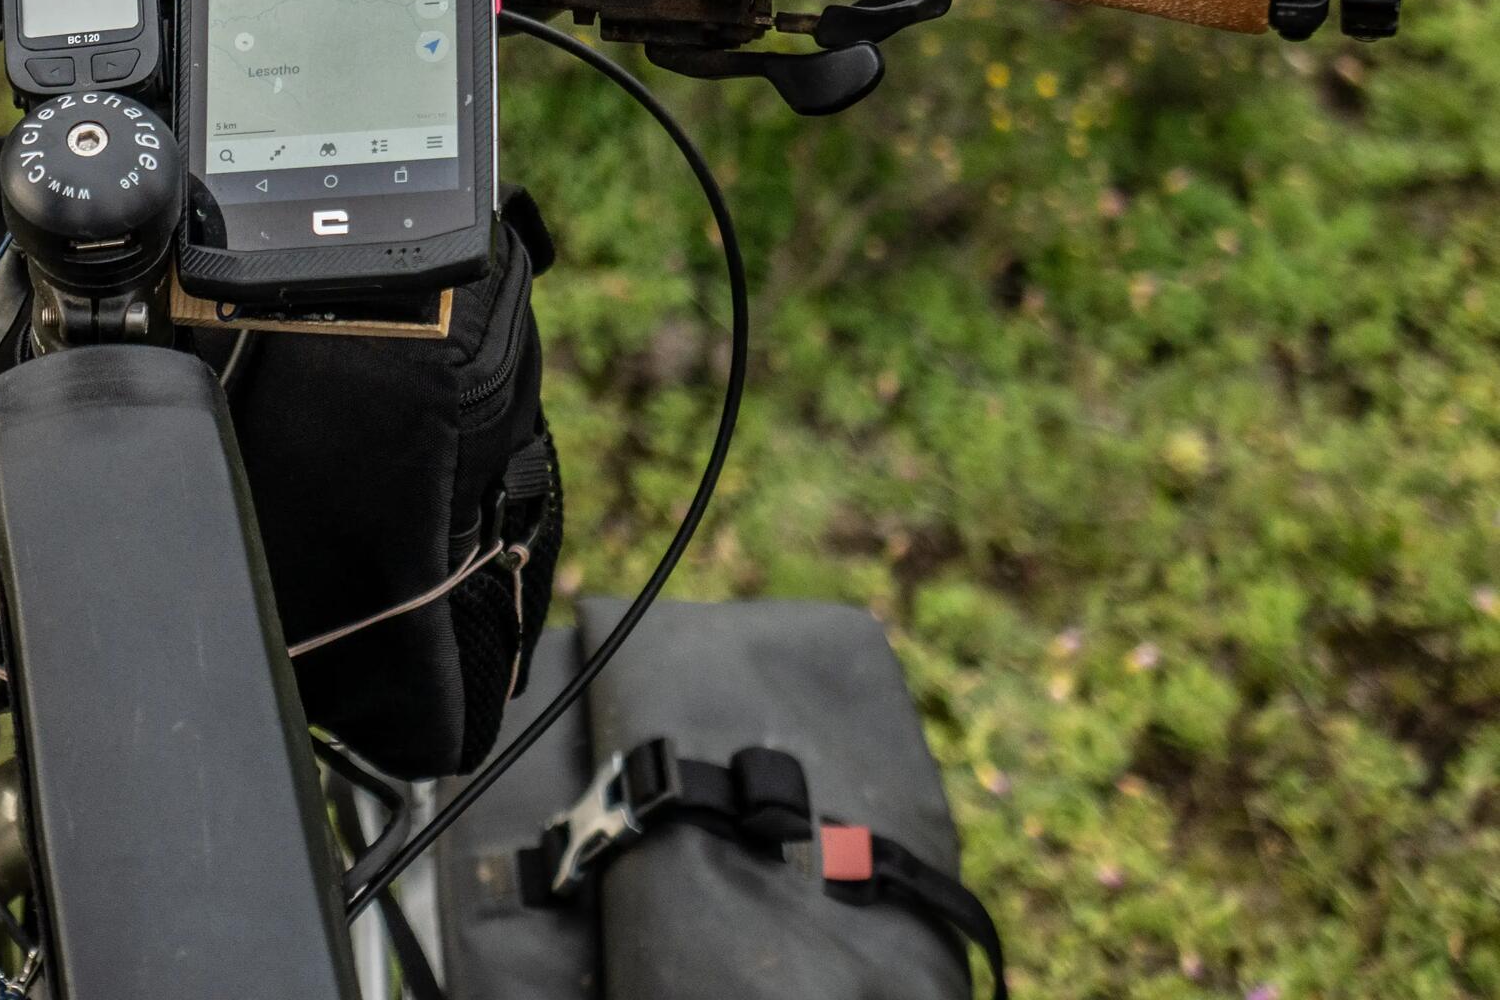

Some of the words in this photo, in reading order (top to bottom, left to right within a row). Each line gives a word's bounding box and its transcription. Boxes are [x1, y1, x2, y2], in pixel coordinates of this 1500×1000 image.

[67, 35, 81, 45] BC
[83, 33, 100, 43] 120
[248, 63, 300, 78] Lesotho
[215, 122, 222, 131] 5
[223, 121, 237, 130] km
